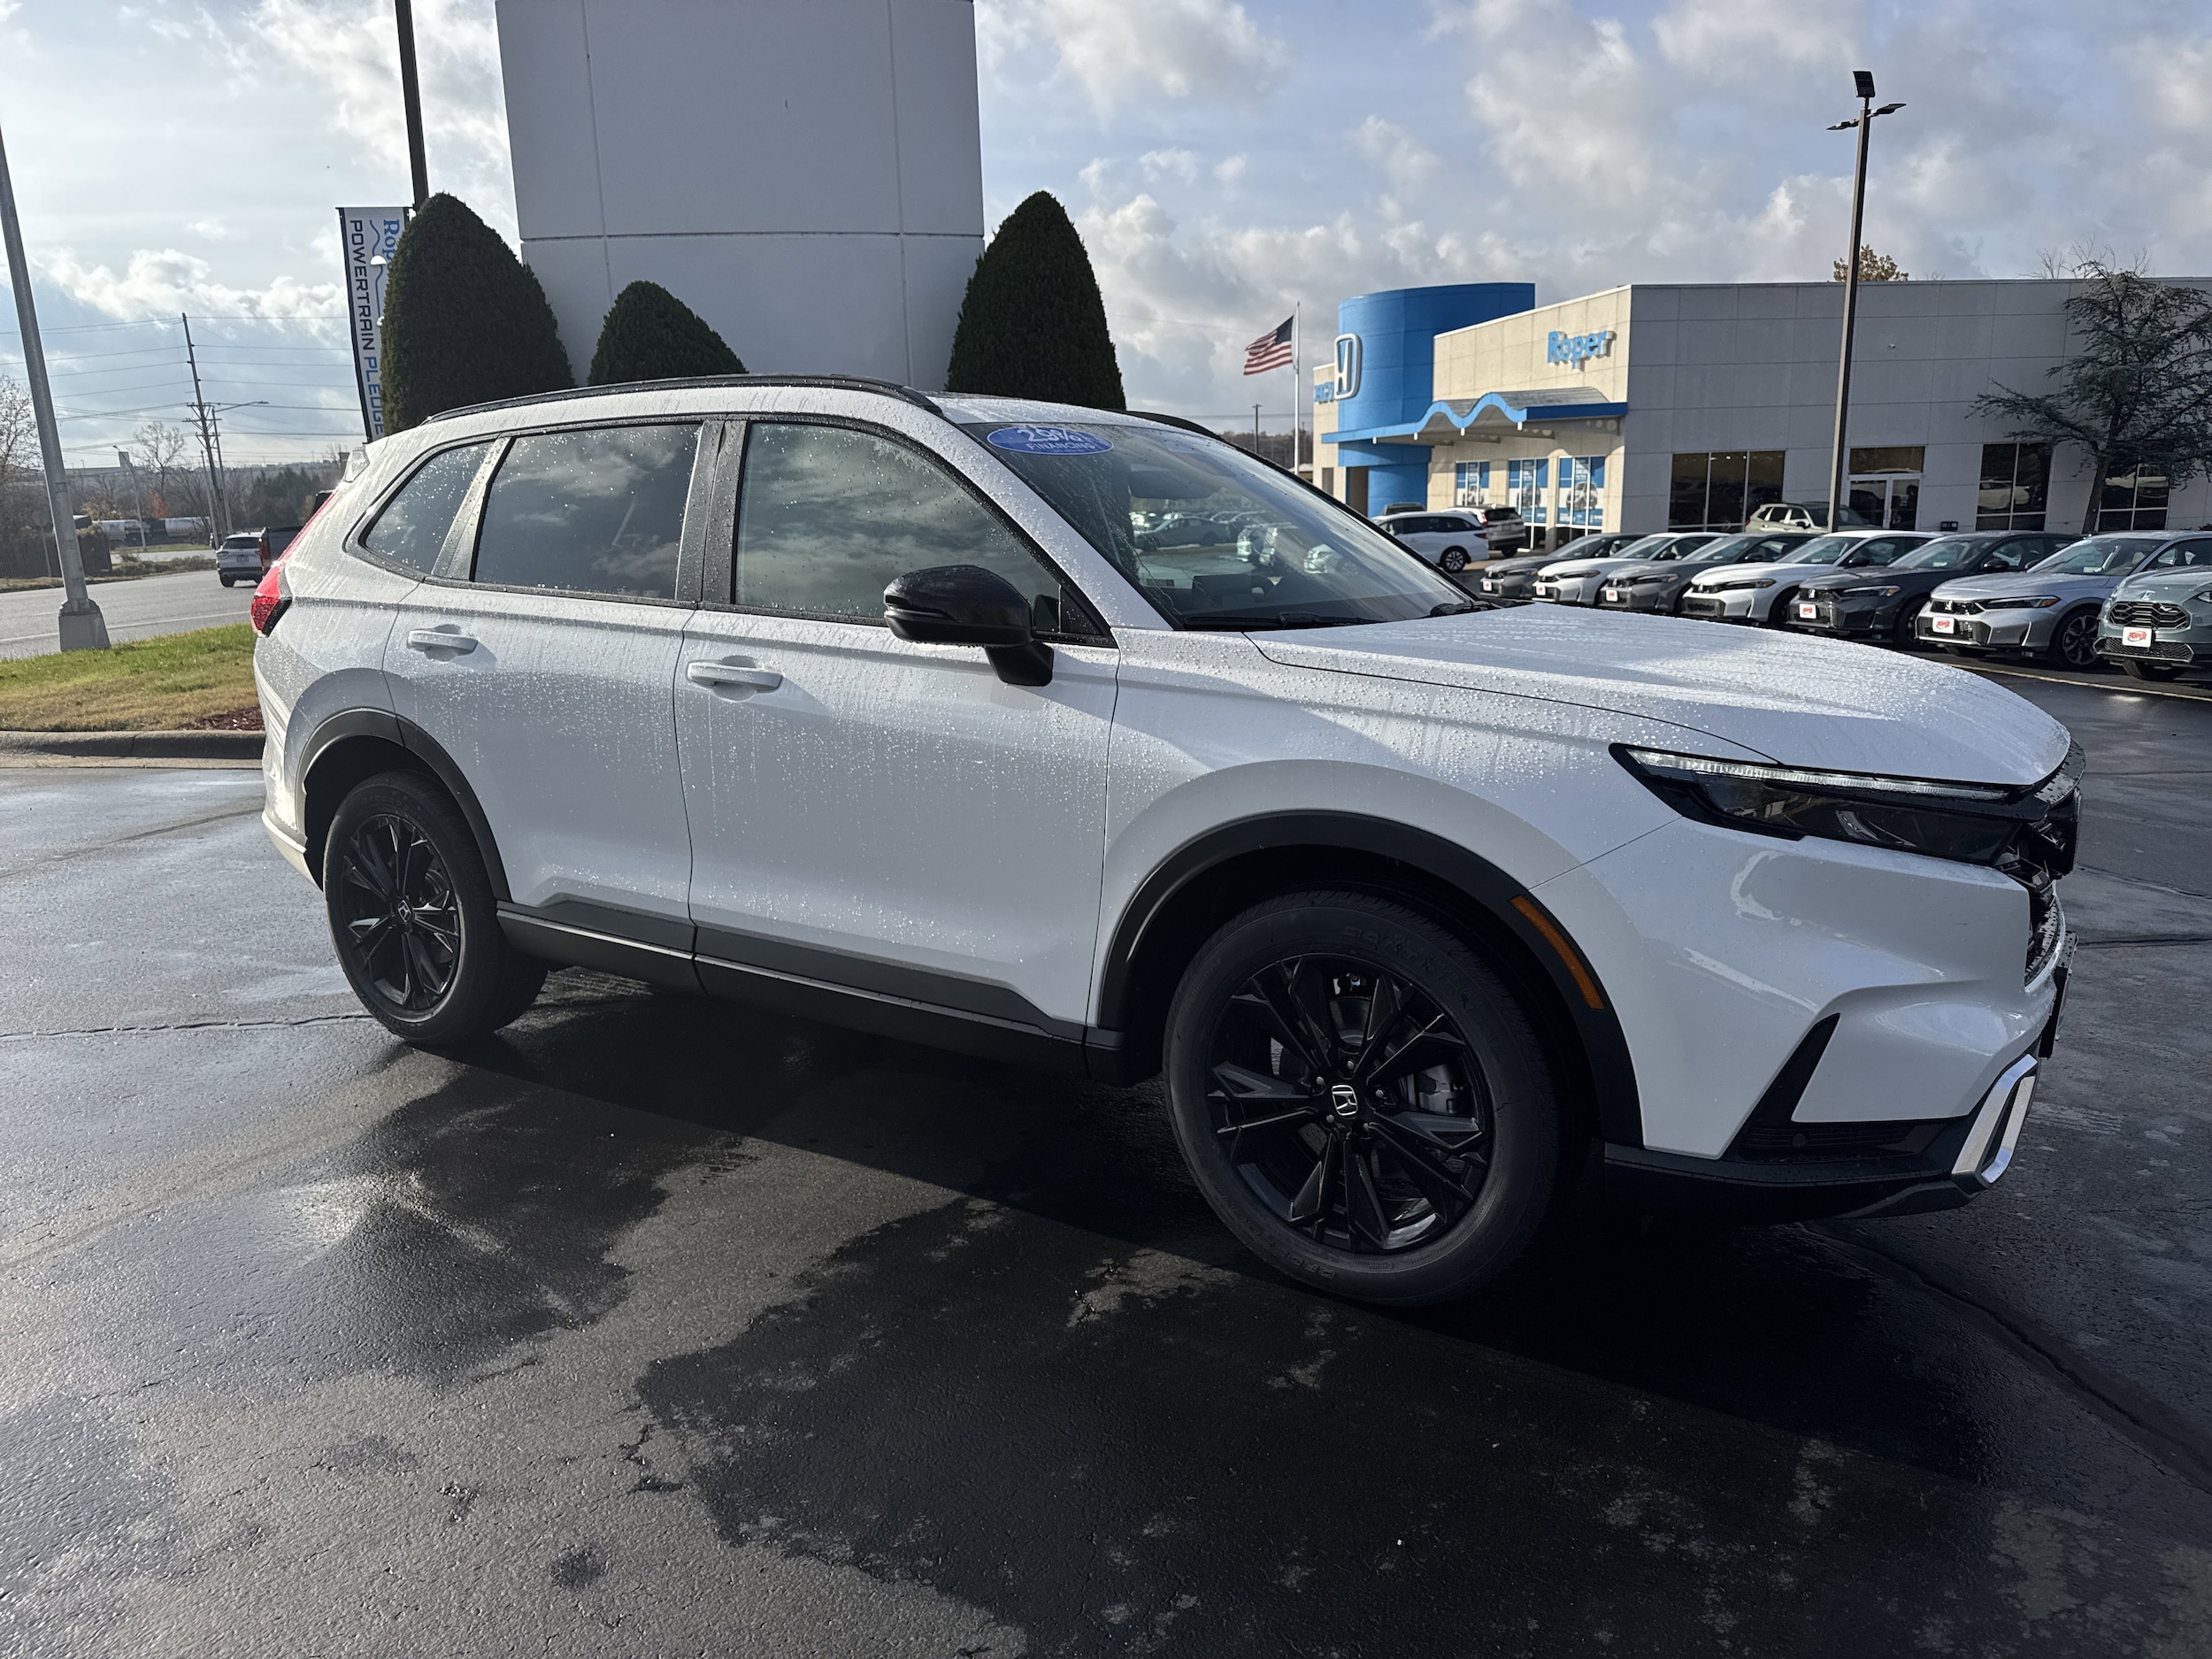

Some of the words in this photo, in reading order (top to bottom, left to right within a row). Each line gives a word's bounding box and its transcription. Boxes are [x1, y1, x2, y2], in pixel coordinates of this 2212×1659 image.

[349, 220, 375, 350] POWERTRAIN
[364, 357, 384, 434] PLEDGE
[1547, 330, 1612, 370] Roper
